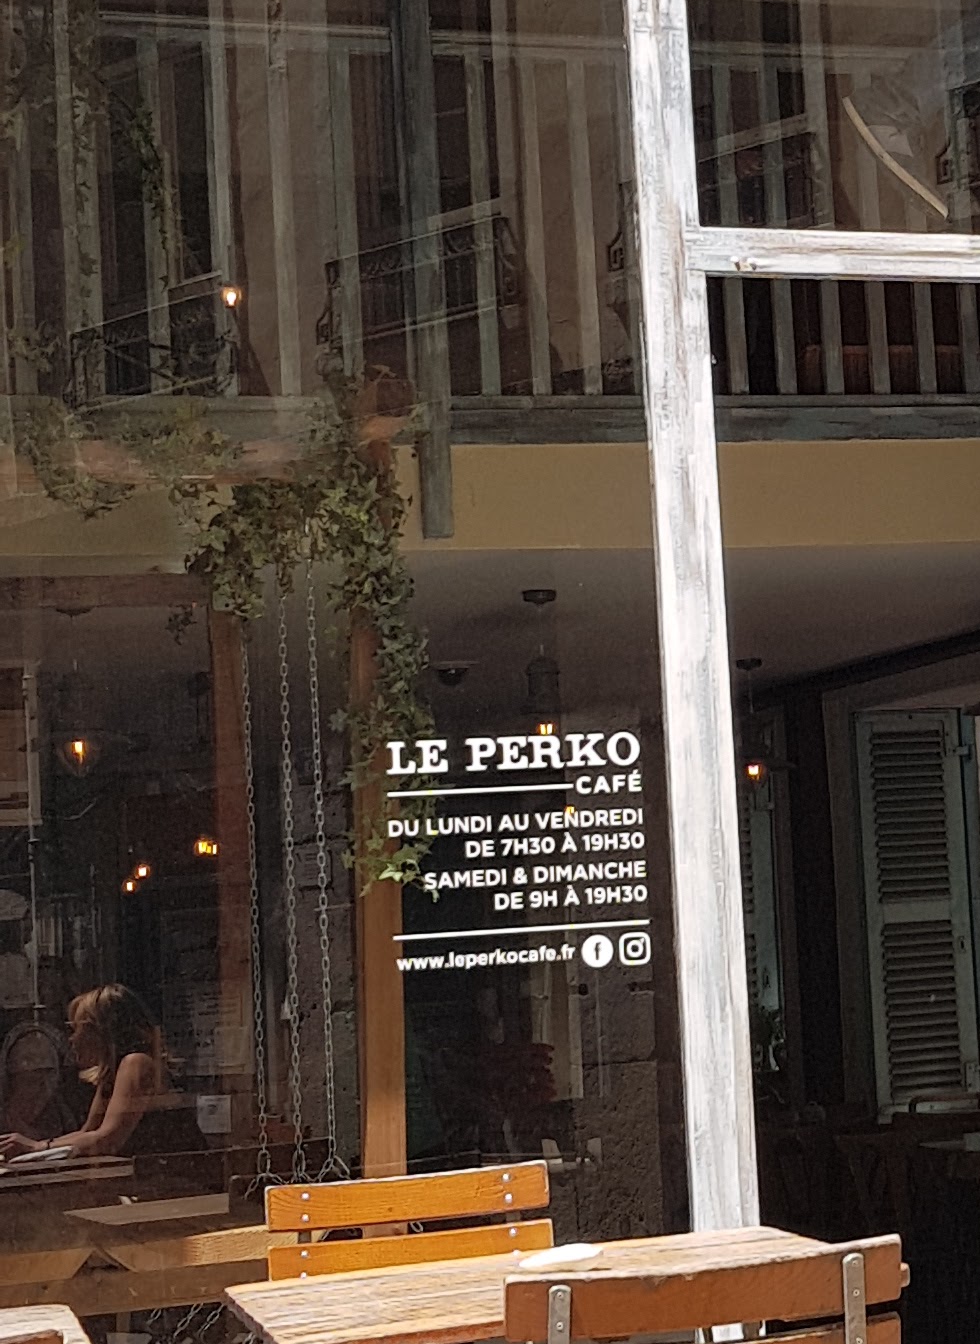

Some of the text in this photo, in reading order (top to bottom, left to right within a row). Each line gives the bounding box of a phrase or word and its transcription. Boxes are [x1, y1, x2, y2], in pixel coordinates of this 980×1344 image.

[386, 731, 641, 775] LE PERKO
[575, 770, 643, 795] CAFÉ
[388, 808, 644, 838] DU LUNDI AU VENDREDI
[465, 832, 645, 858] DE 7H30 À 19H30
[424, 860, 646, 890] SAMEDI & DIMANCHE
[494, 885, 648, 911] DE 9H À 19H30
[396, 945, 576, 970] www.leperkocafe.fr
